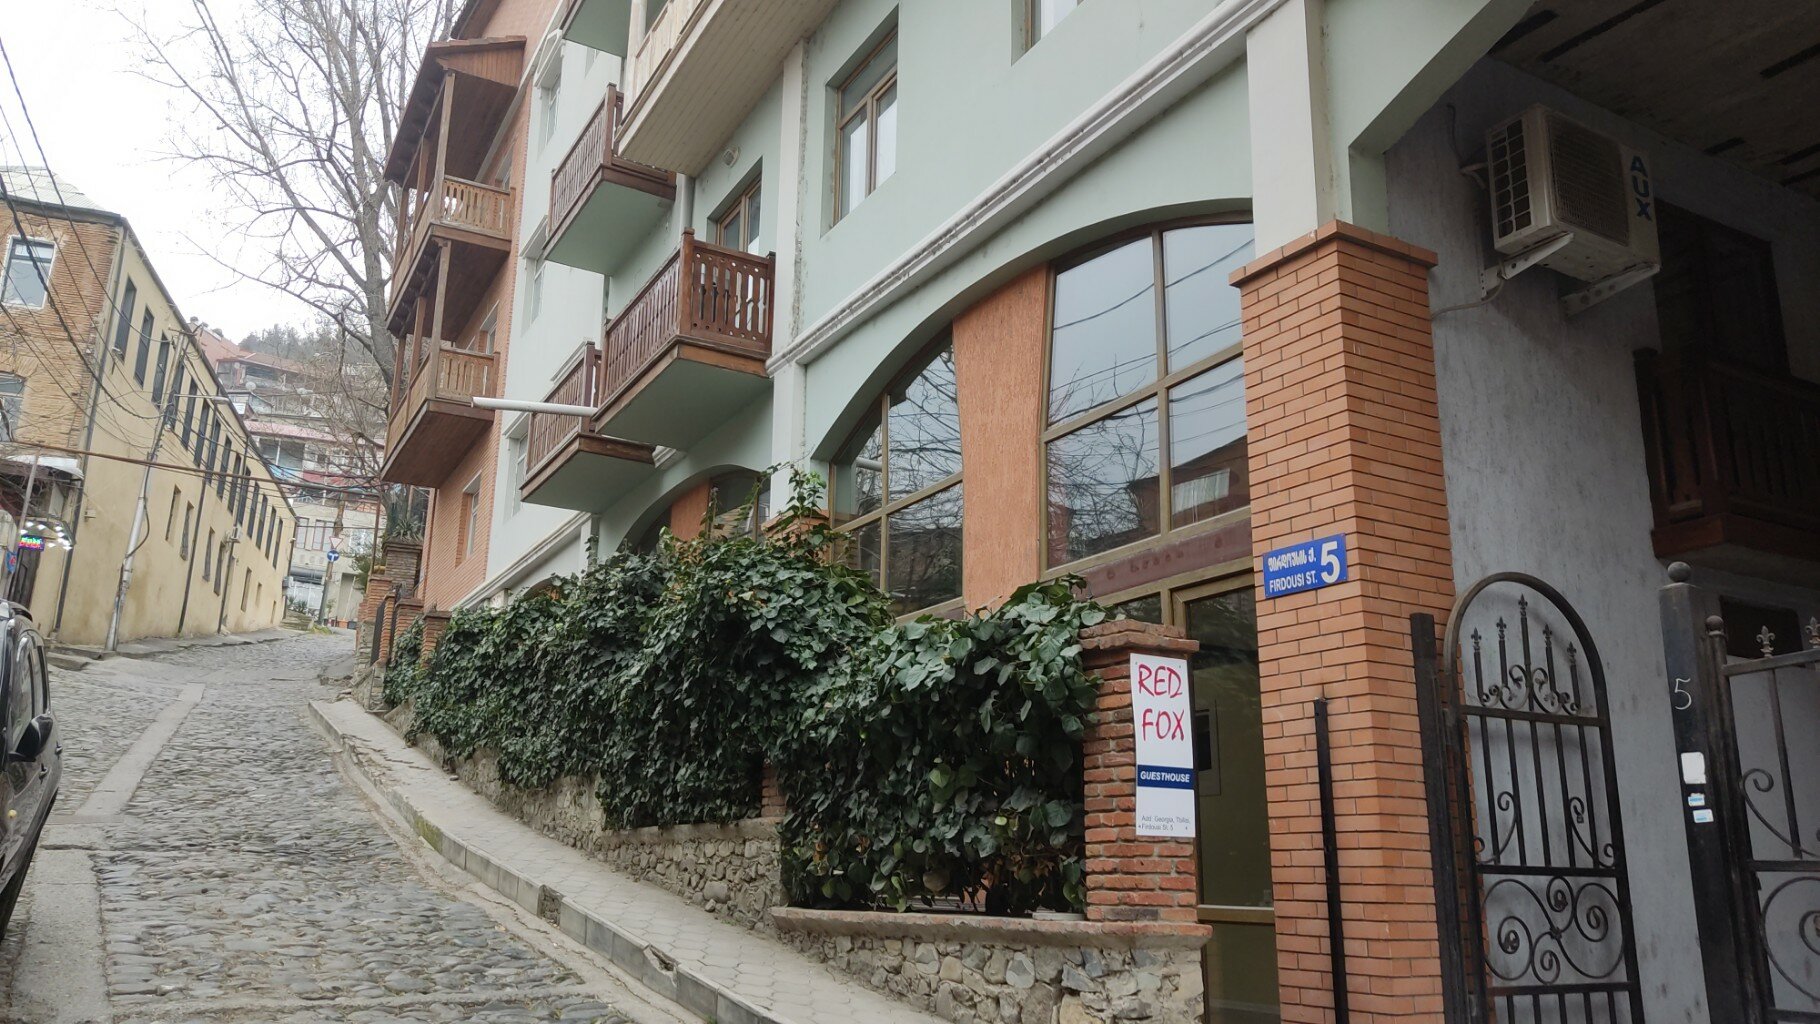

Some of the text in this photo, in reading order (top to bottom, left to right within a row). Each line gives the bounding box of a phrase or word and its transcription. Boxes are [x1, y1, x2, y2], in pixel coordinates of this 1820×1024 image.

[1630, 155, 1653, 222] AUX
[1320, 540, 1341, 584] 5
[1269, 570, 1318, 593] FIRDOUSI ST.
[1138, 663, 1183, 699] RED
[1674, 677, 1692, 710] 5
[1141, 708, 1185, 741] FOX
[1140, 770, 1190, 783] GUESTHOUSE
